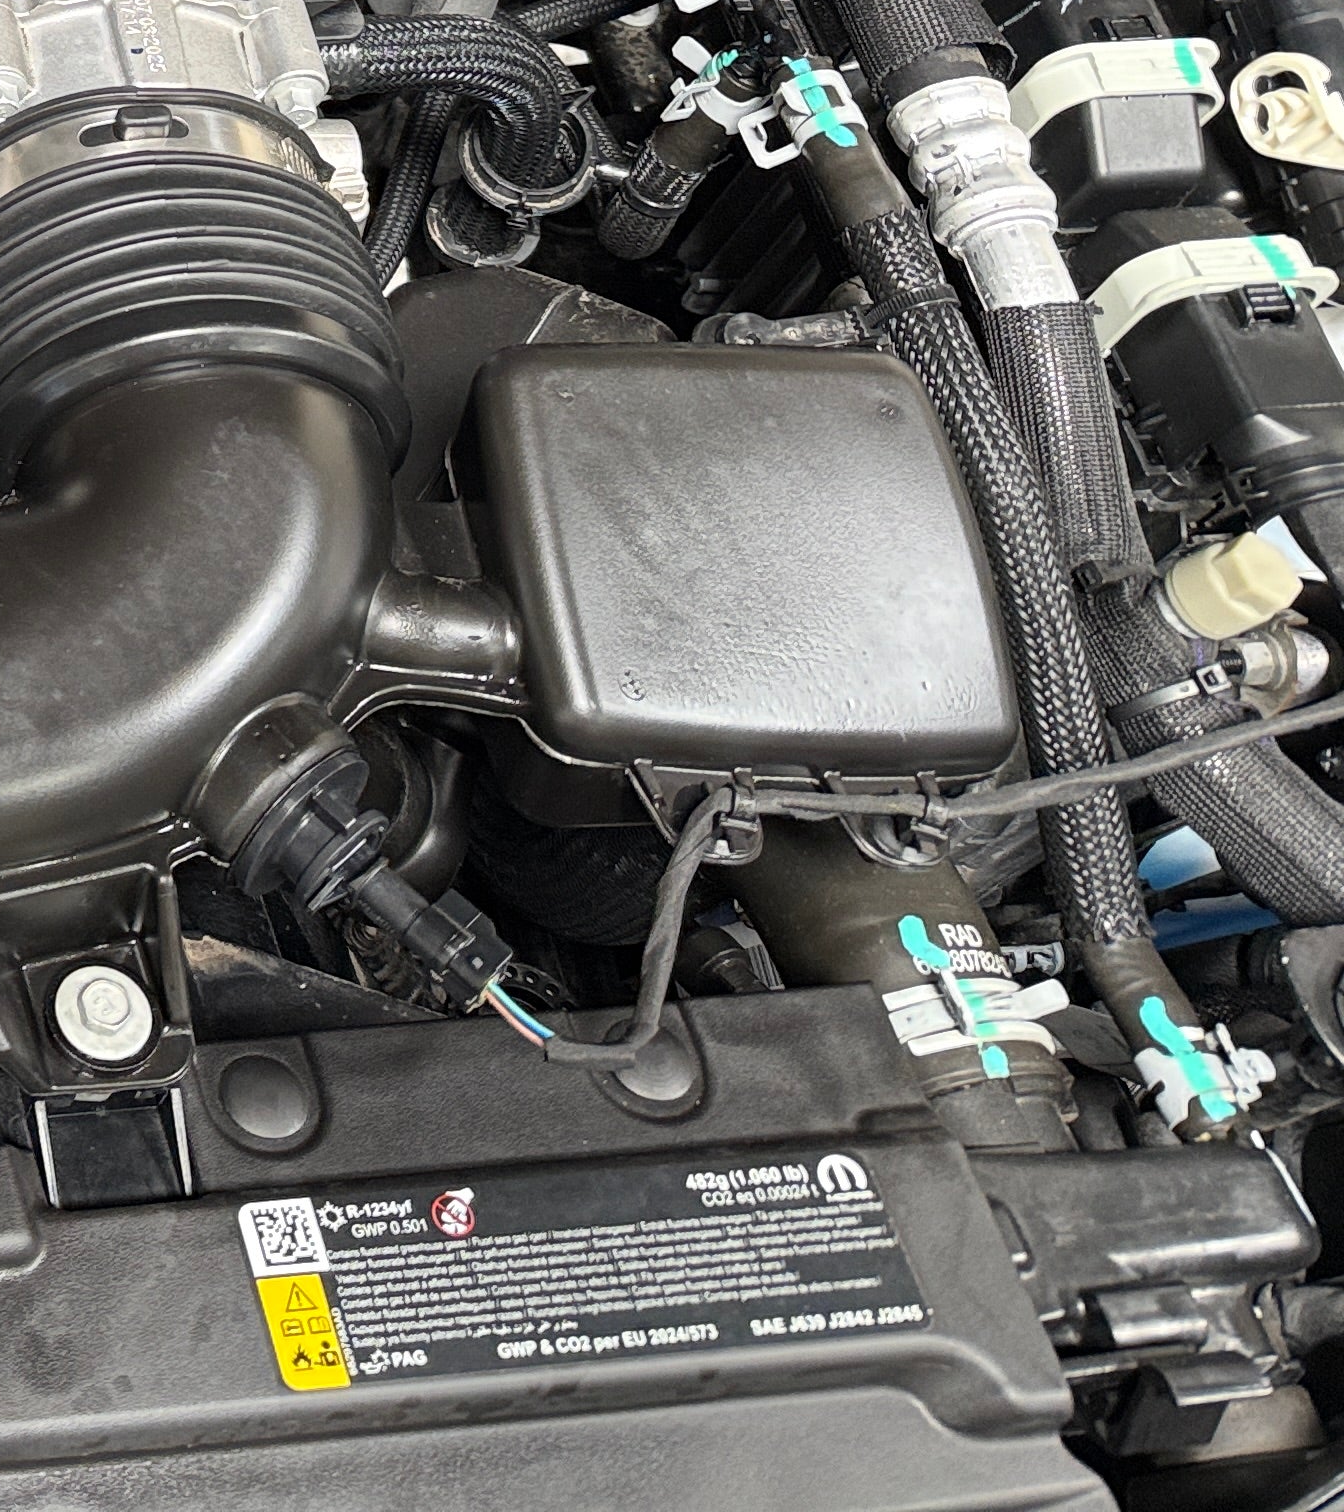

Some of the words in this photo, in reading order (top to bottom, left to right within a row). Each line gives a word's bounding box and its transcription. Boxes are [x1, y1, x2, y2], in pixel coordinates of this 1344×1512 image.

[938, 923, 983, 948] RAD
[685, 1172, 730, 1191] 482g
[784, 1164, 809, 1184] lb)
[346, 1199, 413, 1219] R-1234yf
[701, 1191, 736, 1207] CO2
[350, 1223, 388, 1239] GWP
[389, 1218, 429, 1236] 0.501
[750, 1317, 787, 1337] SAE
[496, 1340, 537, 1360] GWP
[539, 1339, 554, 1355] &
[556, 1335, 592, 1353] CO2
[592, 1336, 620, 1354] per
[622, 1328, 648, 1348] EU
[391, 1349, 428, 1368] PAG
